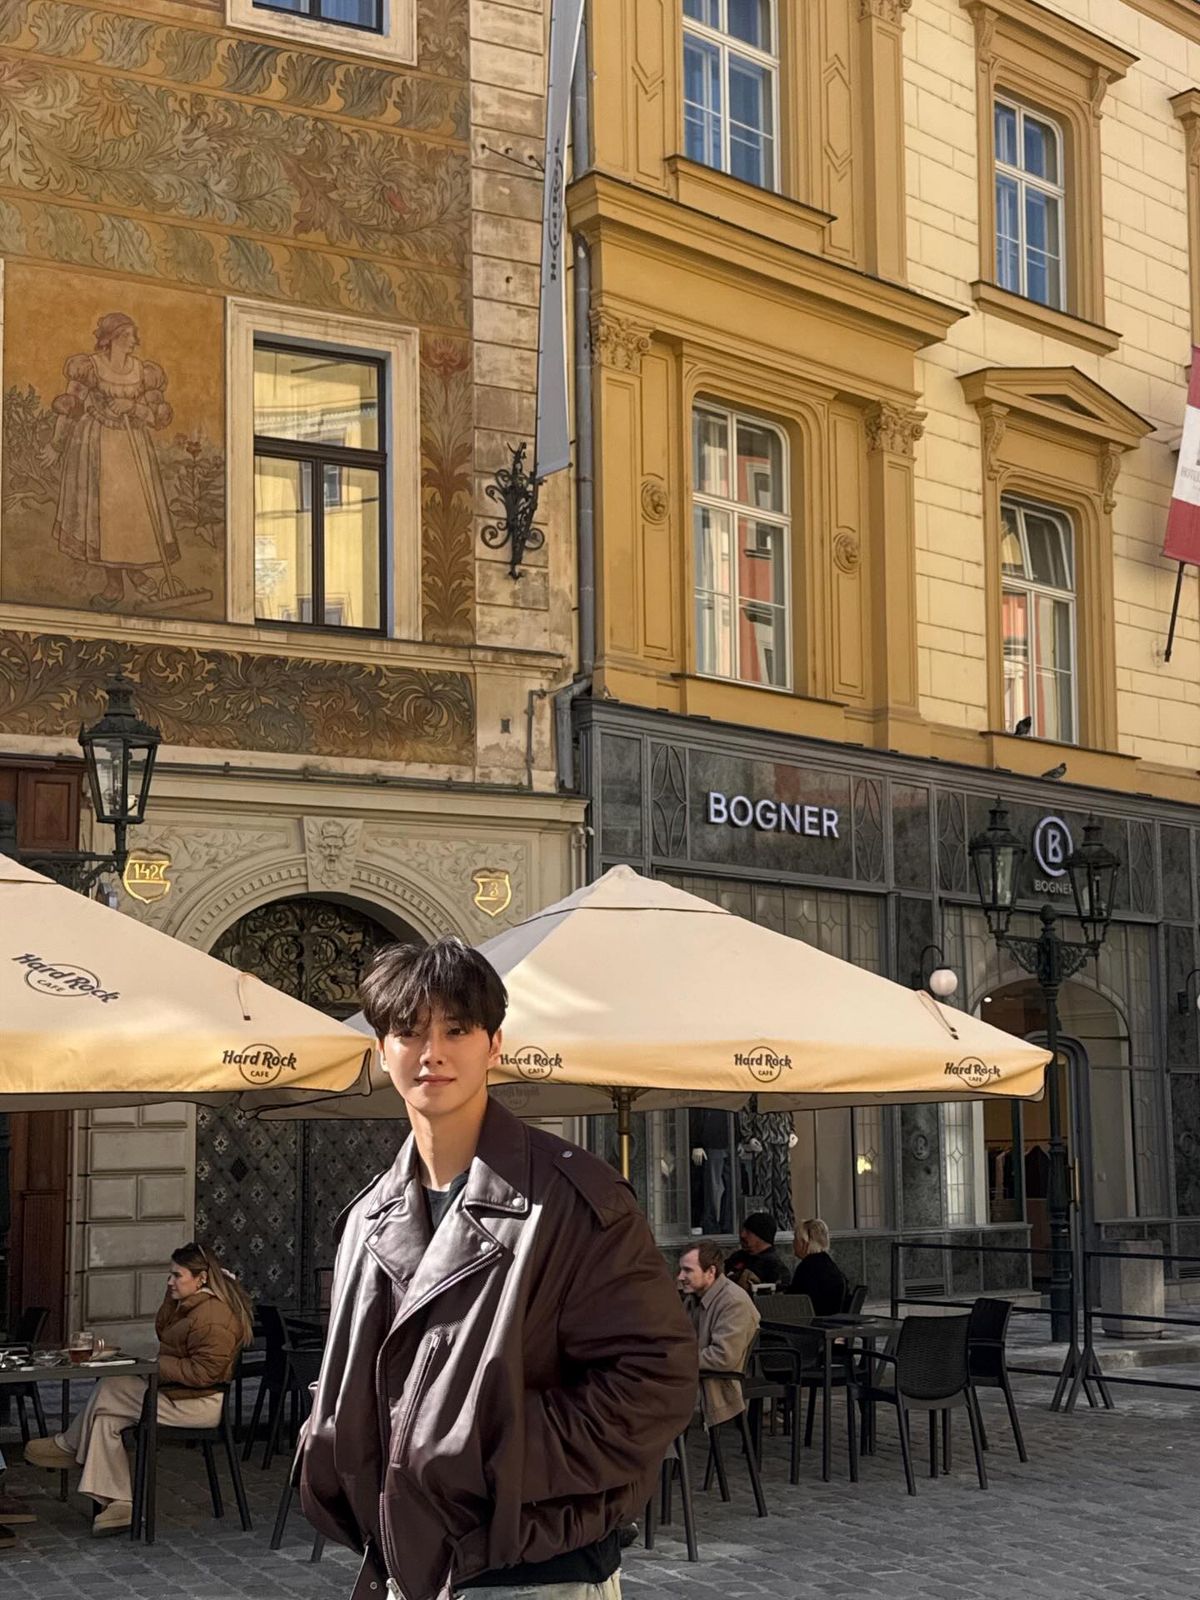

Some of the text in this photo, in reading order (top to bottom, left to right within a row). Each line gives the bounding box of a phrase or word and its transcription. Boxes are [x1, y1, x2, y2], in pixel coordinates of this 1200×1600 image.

[709, 791, 839, 838] BOGNER
[134, 863, 160, 880] 142
[490, 882, 499, 897] 3
[11, 953, 121, 1003] Hard Rock
[37, 979, 66, 992] CAFE
[222, 1049, 297, 1071] Hard Rock
[500, 1053, 564, 1069] Hard Rock
[734, 1053, 793, 1070] Hard Rock
[250, 1070, 269, 1078] CAFE
[944, 1062, 1001, 1078] Hard Rock
